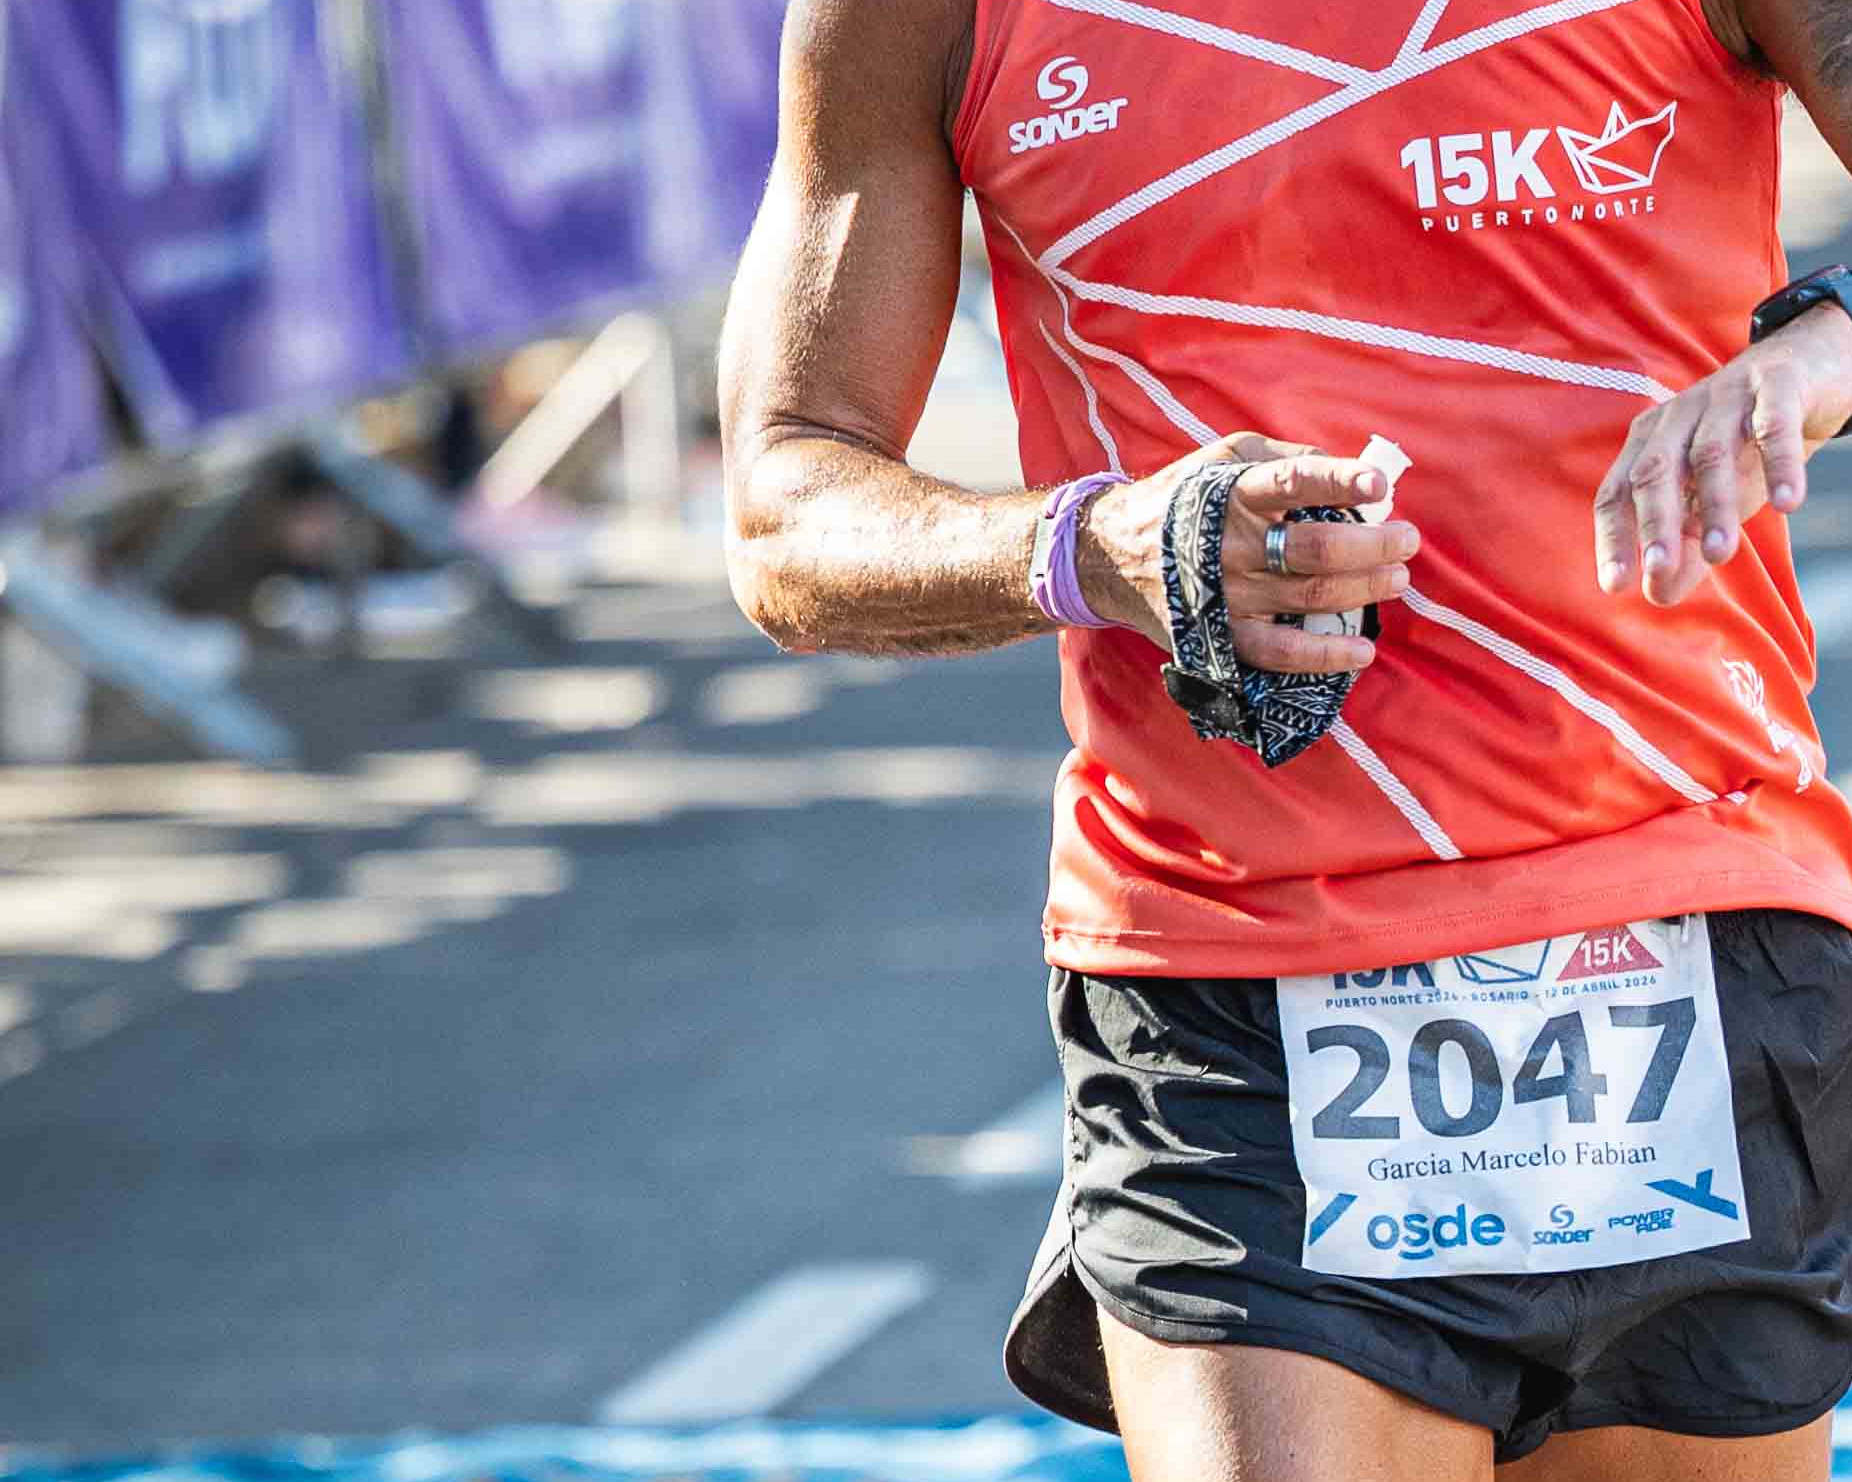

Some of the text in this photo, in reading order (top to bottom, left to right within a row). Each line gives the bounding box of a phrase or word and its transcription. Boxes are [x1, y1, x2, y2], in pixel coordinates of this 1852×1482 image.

[1398, 128, 1557, 209] 15K
[1579, 933, 1634, 969] 15K
[1325, 995, 1378, 1010] PUERTO
[1380, 992, 1422, 1007] NORTE
[1581, 980, 1620, 994] ABRIL
[1625, 975, 1658, 989] 2026
[1306, 996, 1697, 1141] 2047
[1367, 1141, 1657, 1182] Garcia Marcelo Fabian
[1366, 1203, 1506, 1260] osde
[1607, 1207, 1676, 1230] POWER
